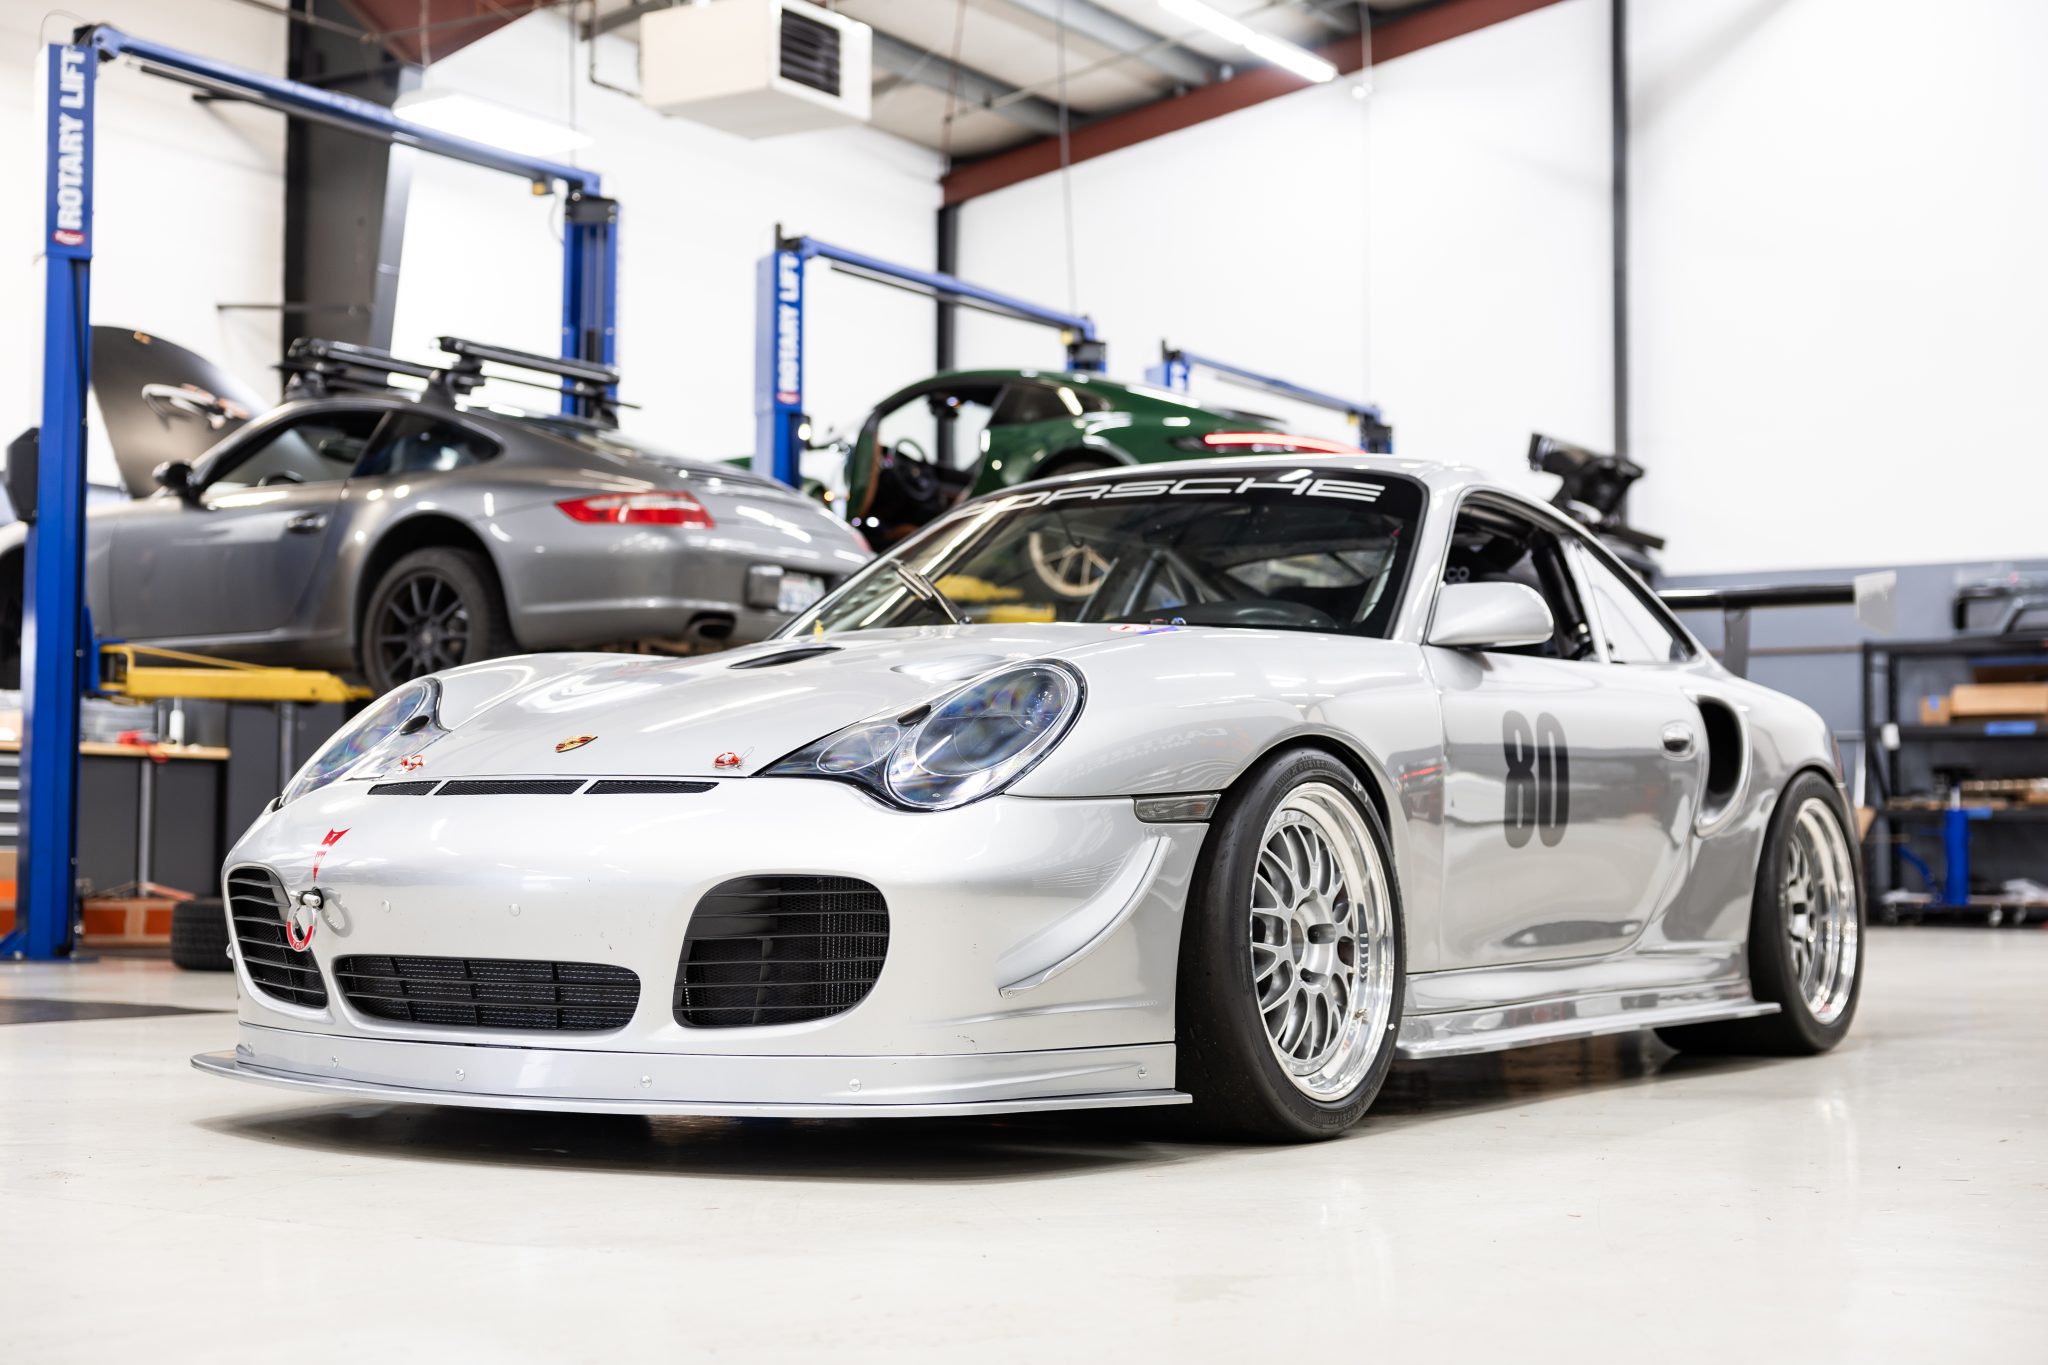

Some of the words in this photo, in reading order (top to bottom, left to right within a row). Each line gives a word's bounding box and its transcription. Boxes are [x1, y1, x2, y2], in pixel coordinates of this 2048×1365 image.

[59, 45, 86, 109] LIFT
[57, 112, 84, 230] ROTARY
[952, 478, 1385, 519] PORSCHE
[1502, 710, 1569, 849] 80
